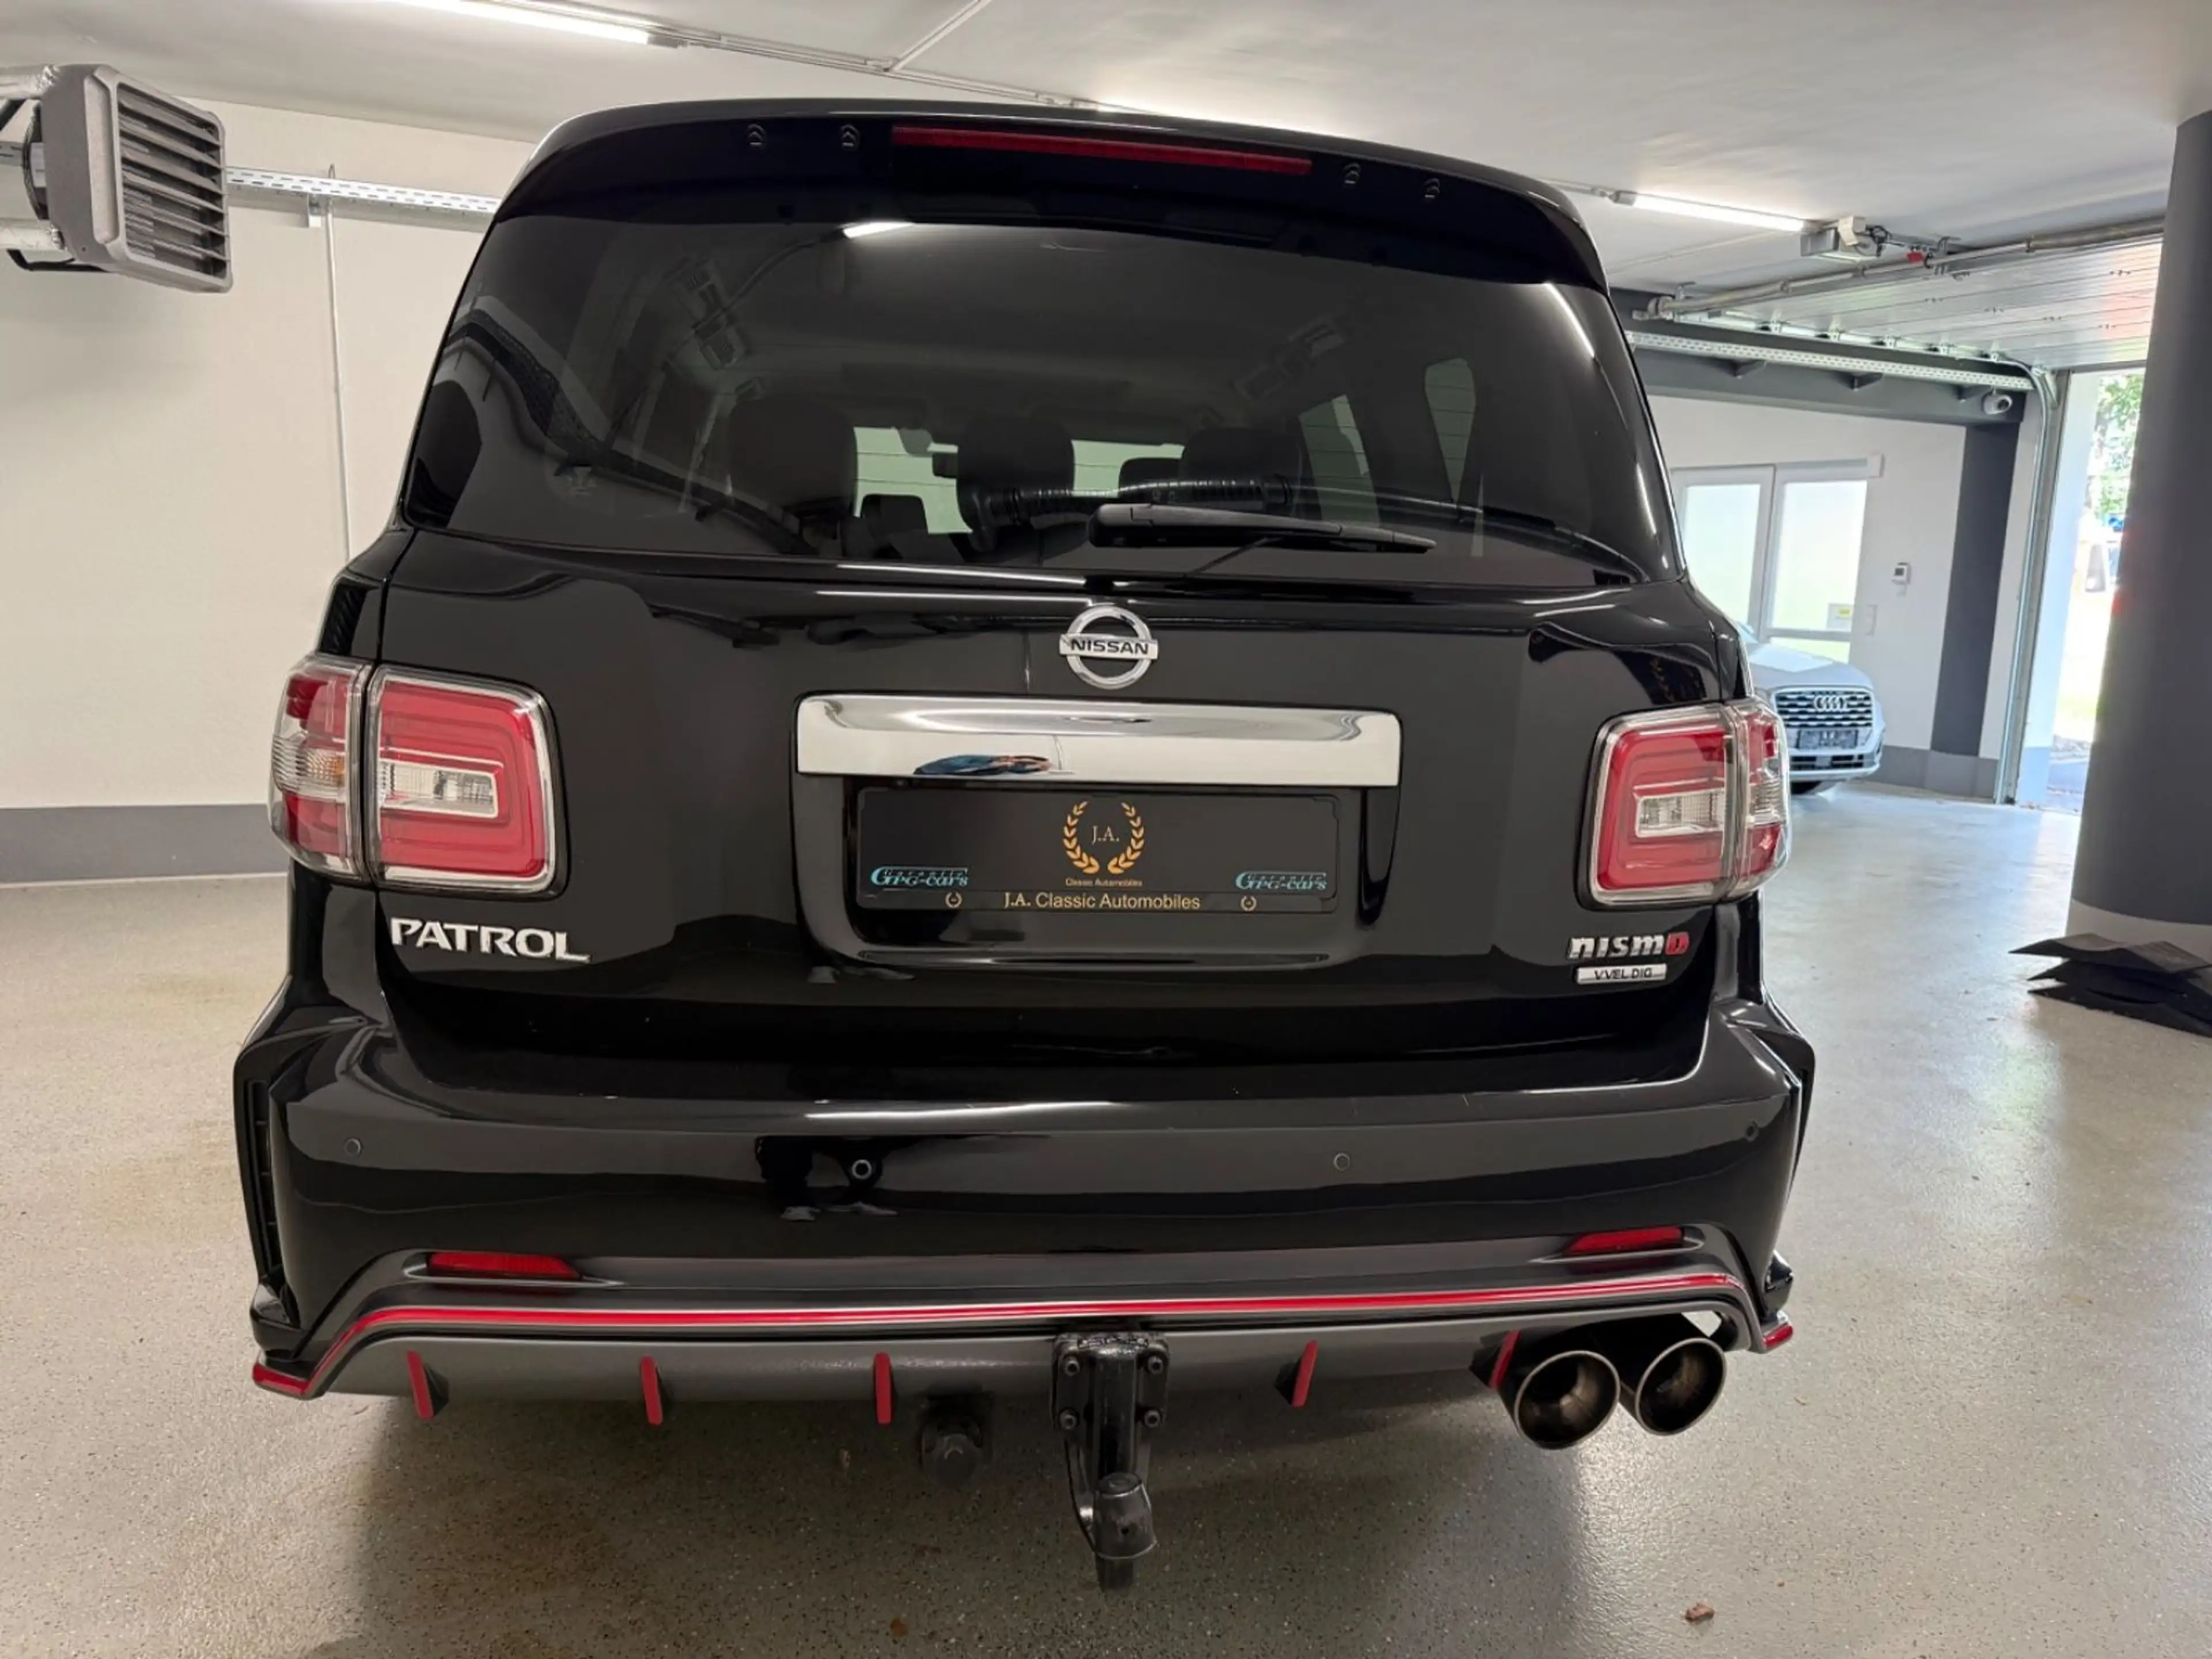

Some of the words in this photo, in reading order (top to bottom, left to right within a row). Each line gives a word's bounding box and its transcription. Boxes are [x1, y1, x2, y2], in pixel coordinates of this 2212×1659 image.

[1070, 638, 1149, 655] NISSAN
[1092, 825, 1120, 845] J.A.
[1004, 892, 1031, 908] J.A.
[1035, 892, 1096, 909] Classic
[1099, 893, 1200, 910] Automobiles
[390, 917, 592, 963] PATROL
